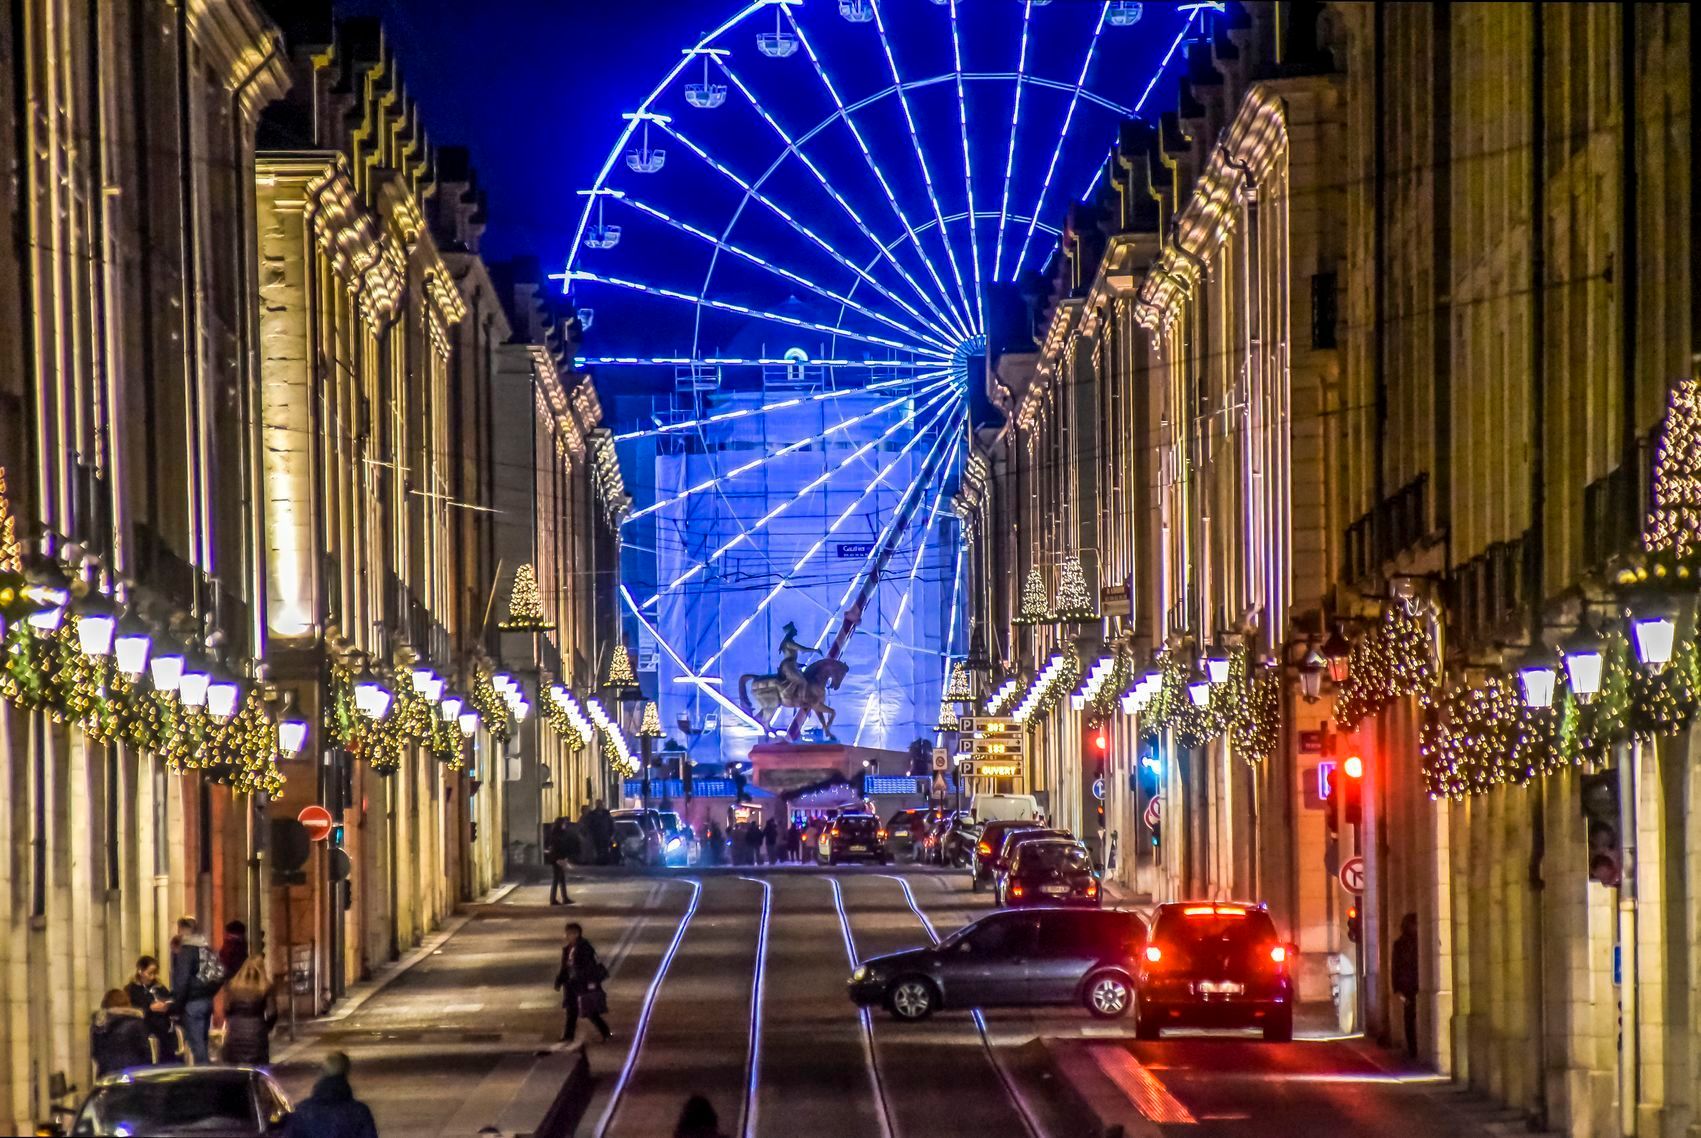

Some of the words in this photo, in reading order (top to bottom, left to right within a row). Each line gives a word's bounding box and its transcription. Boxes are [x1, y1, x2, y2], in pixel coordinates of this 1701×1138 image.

[964, 720, 971, 730] P
[964, 742, 971, 752] P
[964, 764, 971, 773] P
[982, 766, 1016, 775] OUVERT
